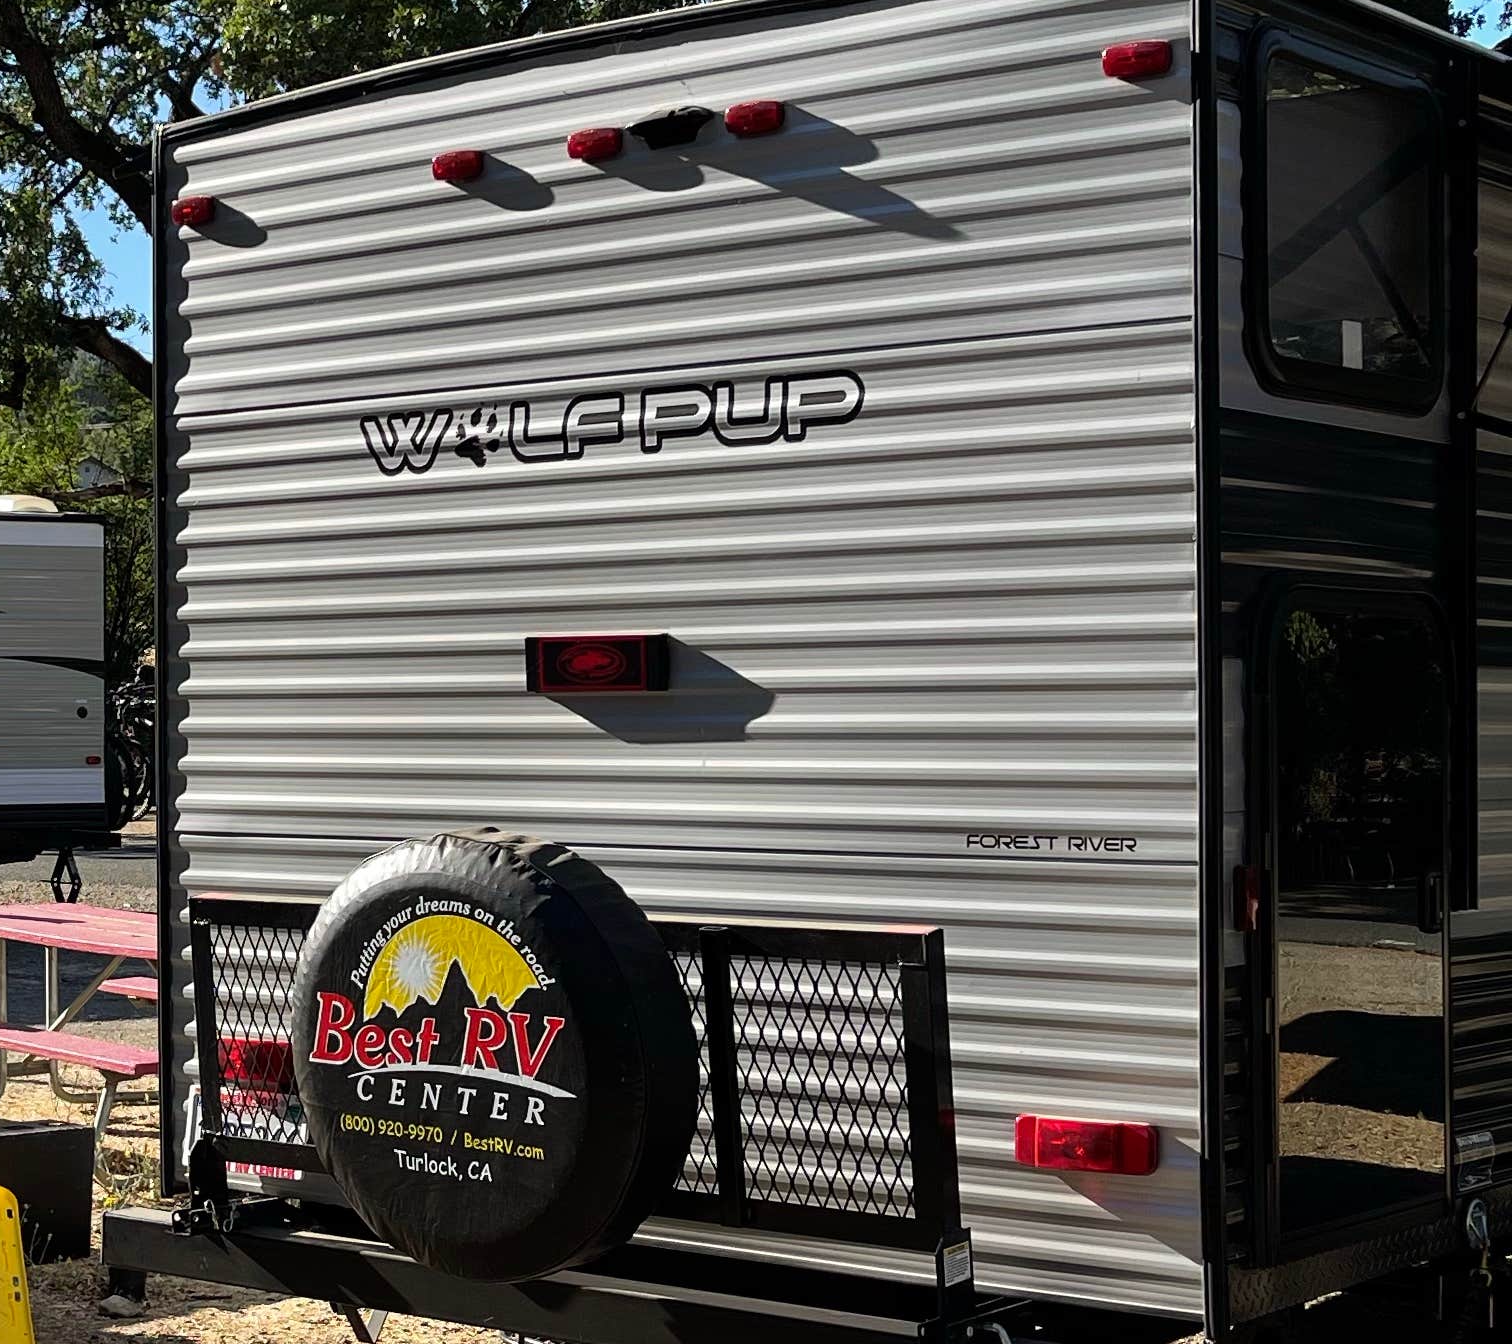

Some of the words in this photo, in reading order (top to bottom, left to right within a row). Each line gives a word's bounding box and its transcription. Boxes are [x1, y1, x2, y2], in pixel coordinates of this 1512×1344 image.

[966, 833, 1059, 851] FOREST
[1068, 836, 1138, 853] RIVER
[350, 928, 387, 991] Putting
[382, 906, 413, 940] your
[415, 895, 472, 916] dreams
[474, 908, 496, 926] on
[496, 919, 522, 946] the
[309, 990, 441, 1070] Best
[461, 1007, 566, 1080] RV
[356, 1074, 546, 1126] CENTER
[340, 1112, 375, 1136] (800)
[378, 1118, 444, 1144] 920-9970
[464, 1131, 546, 1161] BestRV.com
[393, 1148, 464, 1182] Turlock,
[467, 1160, 494, 1183] CA
